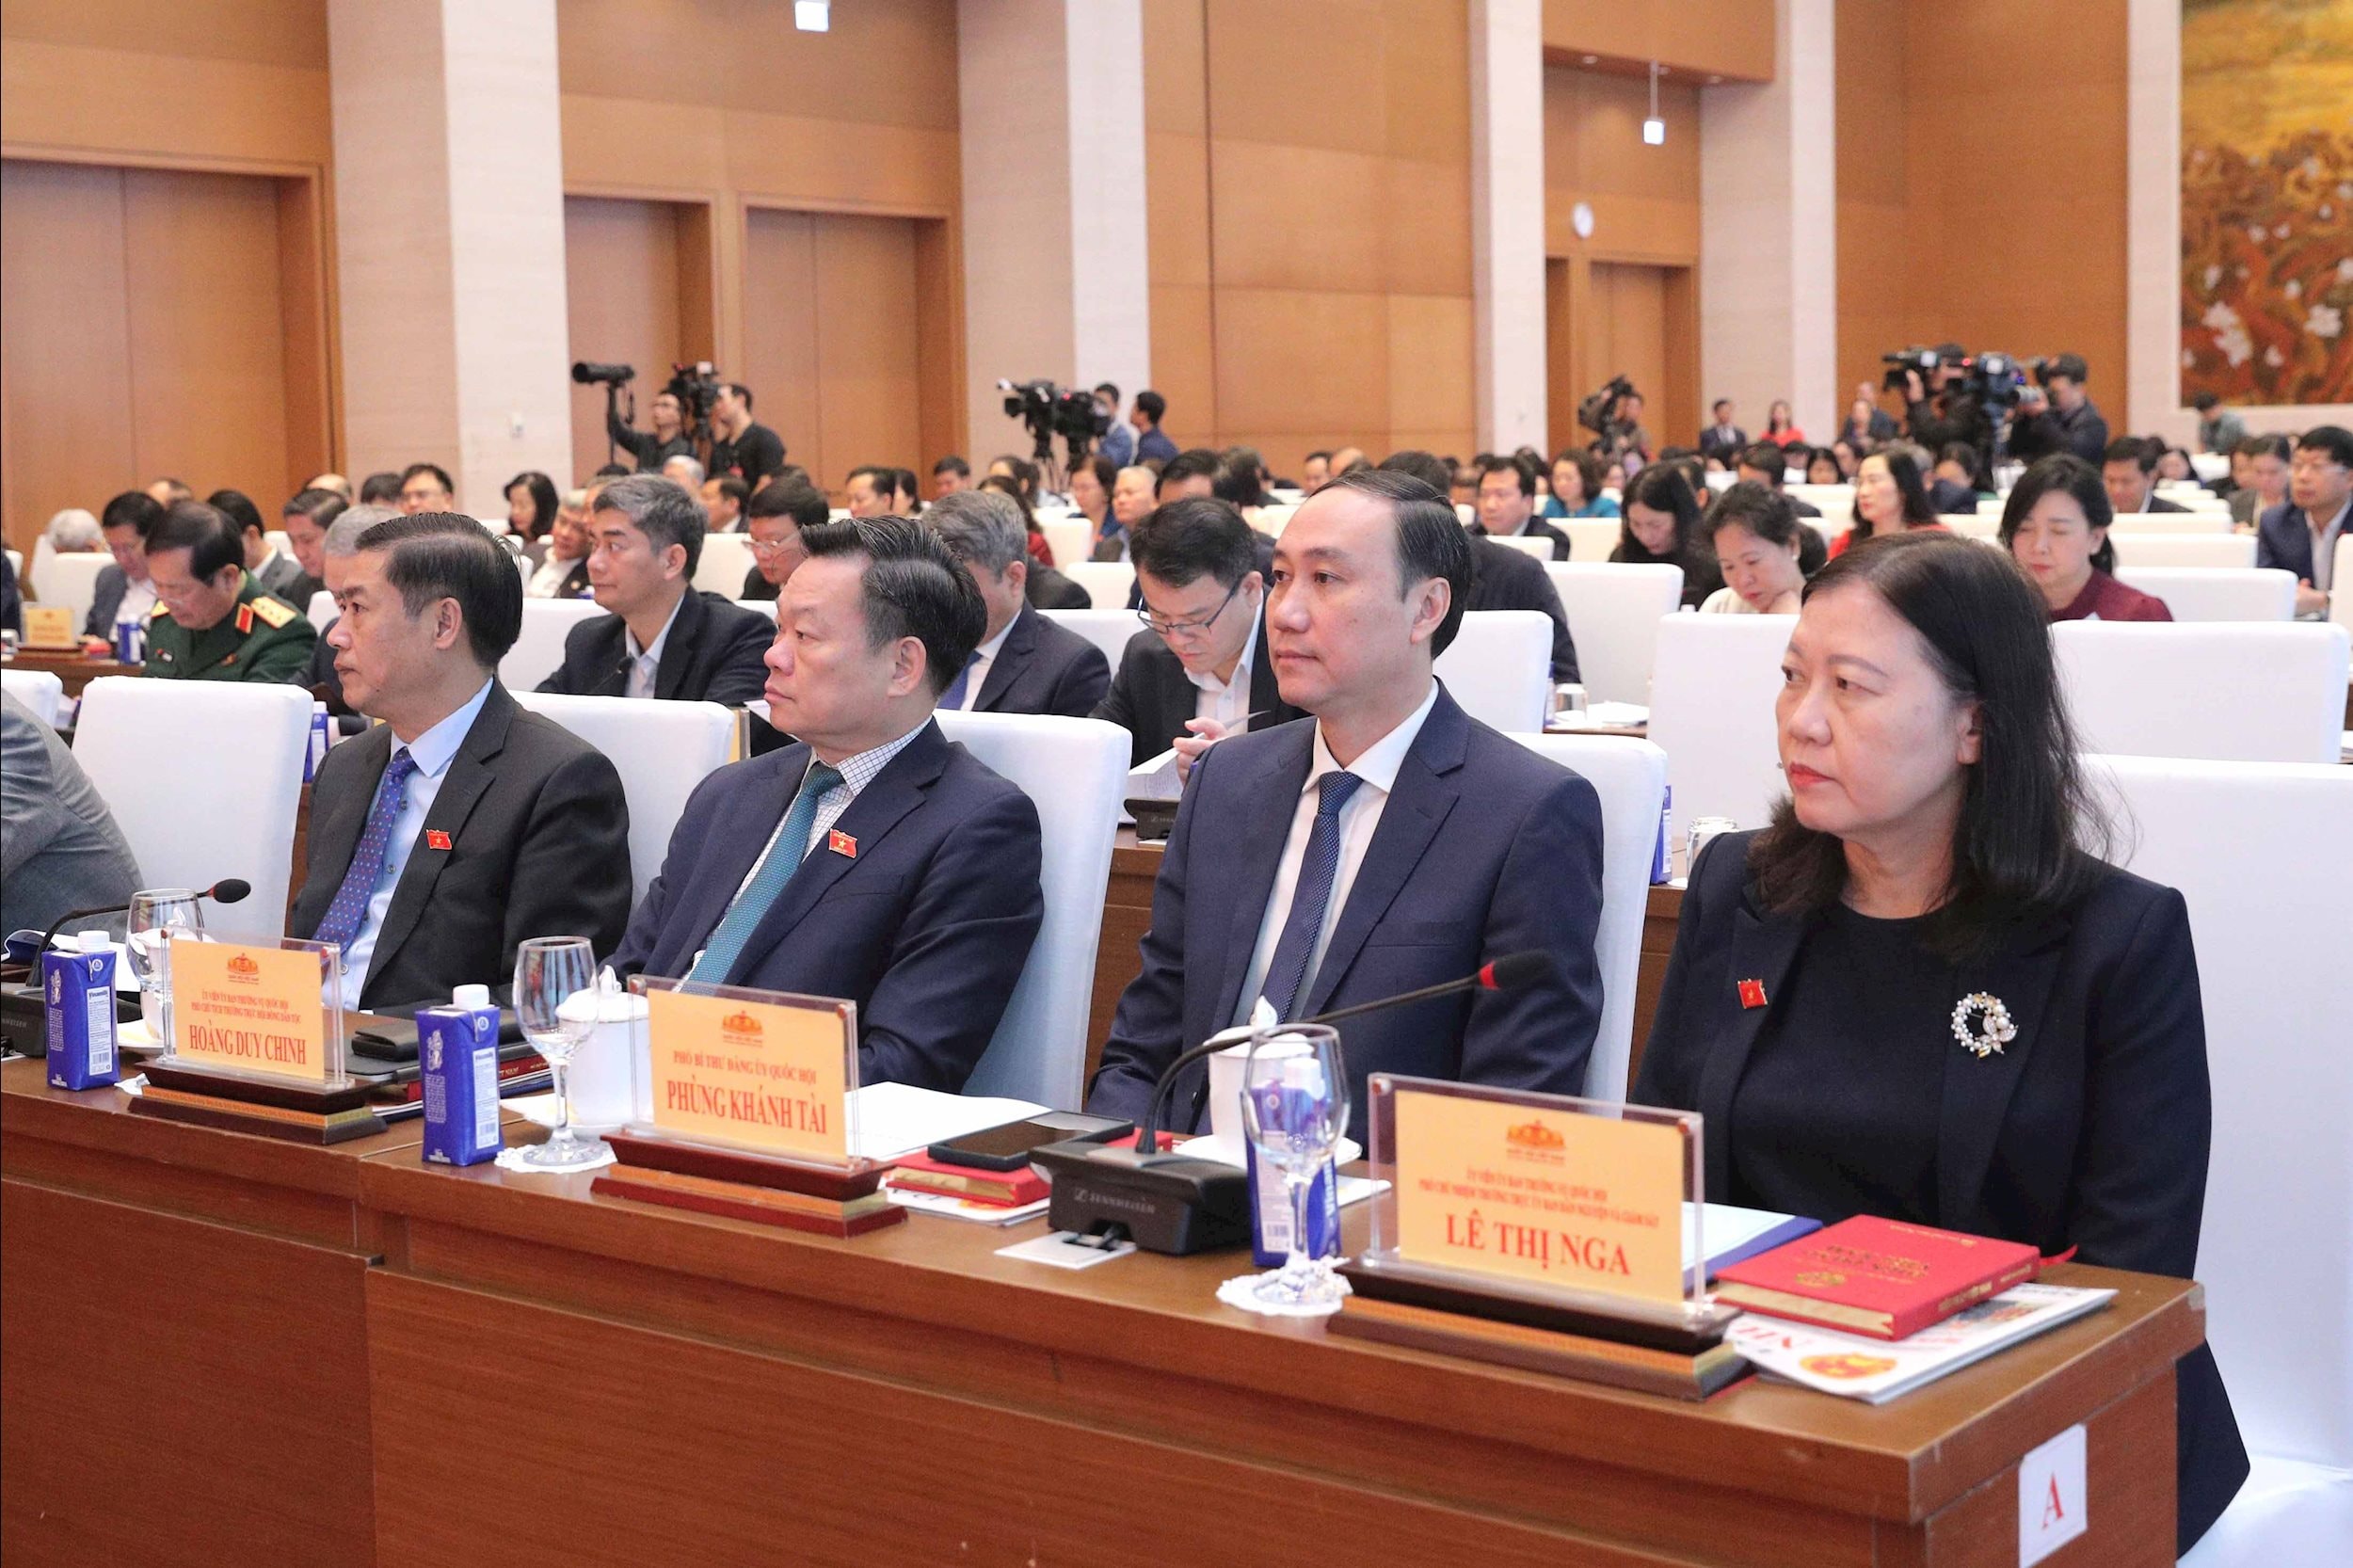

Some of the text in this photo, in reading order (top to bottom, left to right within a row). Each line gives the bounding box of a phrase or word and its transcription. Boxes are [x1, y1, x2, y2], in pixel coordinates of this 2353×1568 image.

[189, 1019, 306, 1064] HOÀNG DUY CHINH
[673, 1049, 693, 1064] PHÓ
[706, 1054, 725, 1070] THƯ
[769, 1063, 797, 1080] QUỐC
[798, 1068, 817, 1085] HỘI
[666, 1074, 827, 1134] PHÙNG KHÁNH TÀI
[1446, 1208, 1631, 1275] LÊ THỊ NGA
[2041, 1473, 2064, 1530] A
